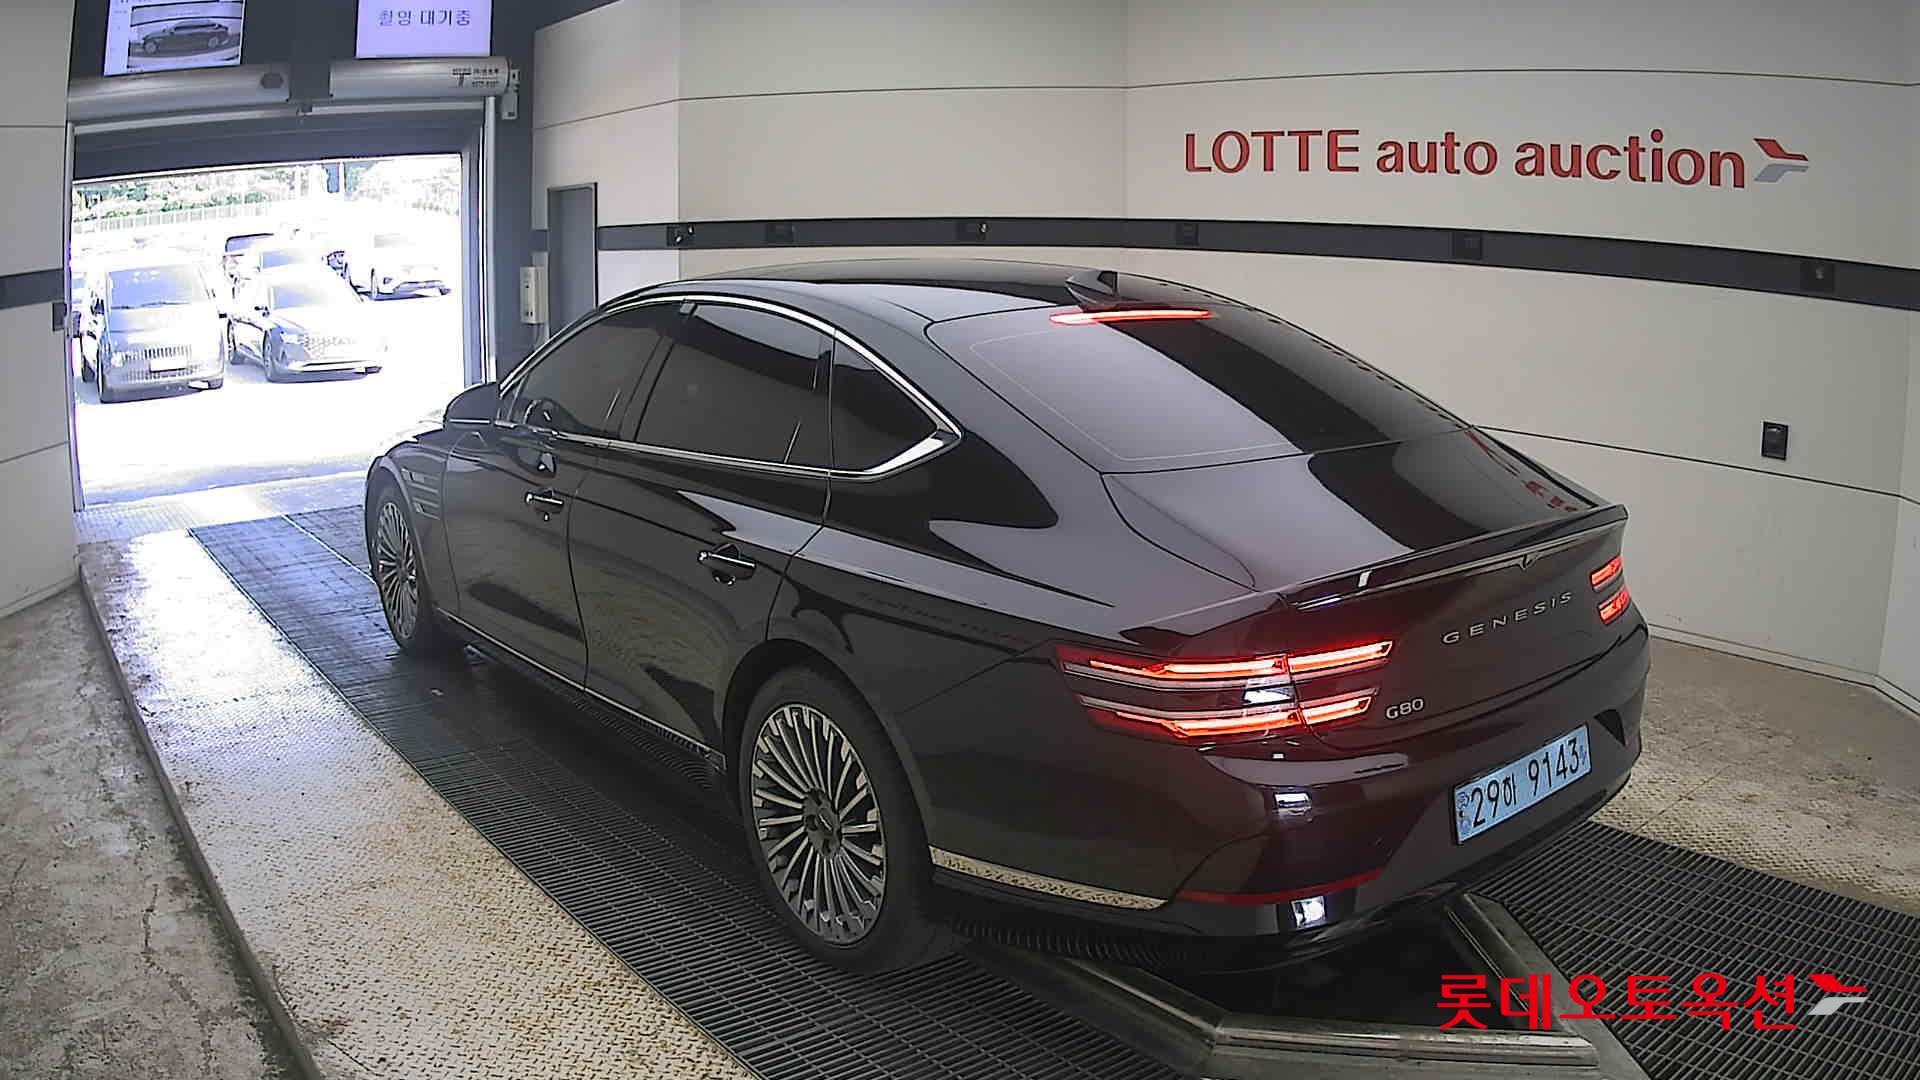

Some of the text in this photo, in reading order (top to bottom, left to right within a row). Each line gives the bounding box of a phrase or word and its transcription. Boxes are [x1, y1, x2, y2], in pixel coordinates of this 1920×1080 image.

[420, 9, 471, 26] 대기중
[1184, 128, 1746, 189] LOTTE auto auction
[1442, 591, 1572, 644] GENESIS
[1385, 697, 1425, 719] G80
[1528, 737, 1580, 796] 9143
